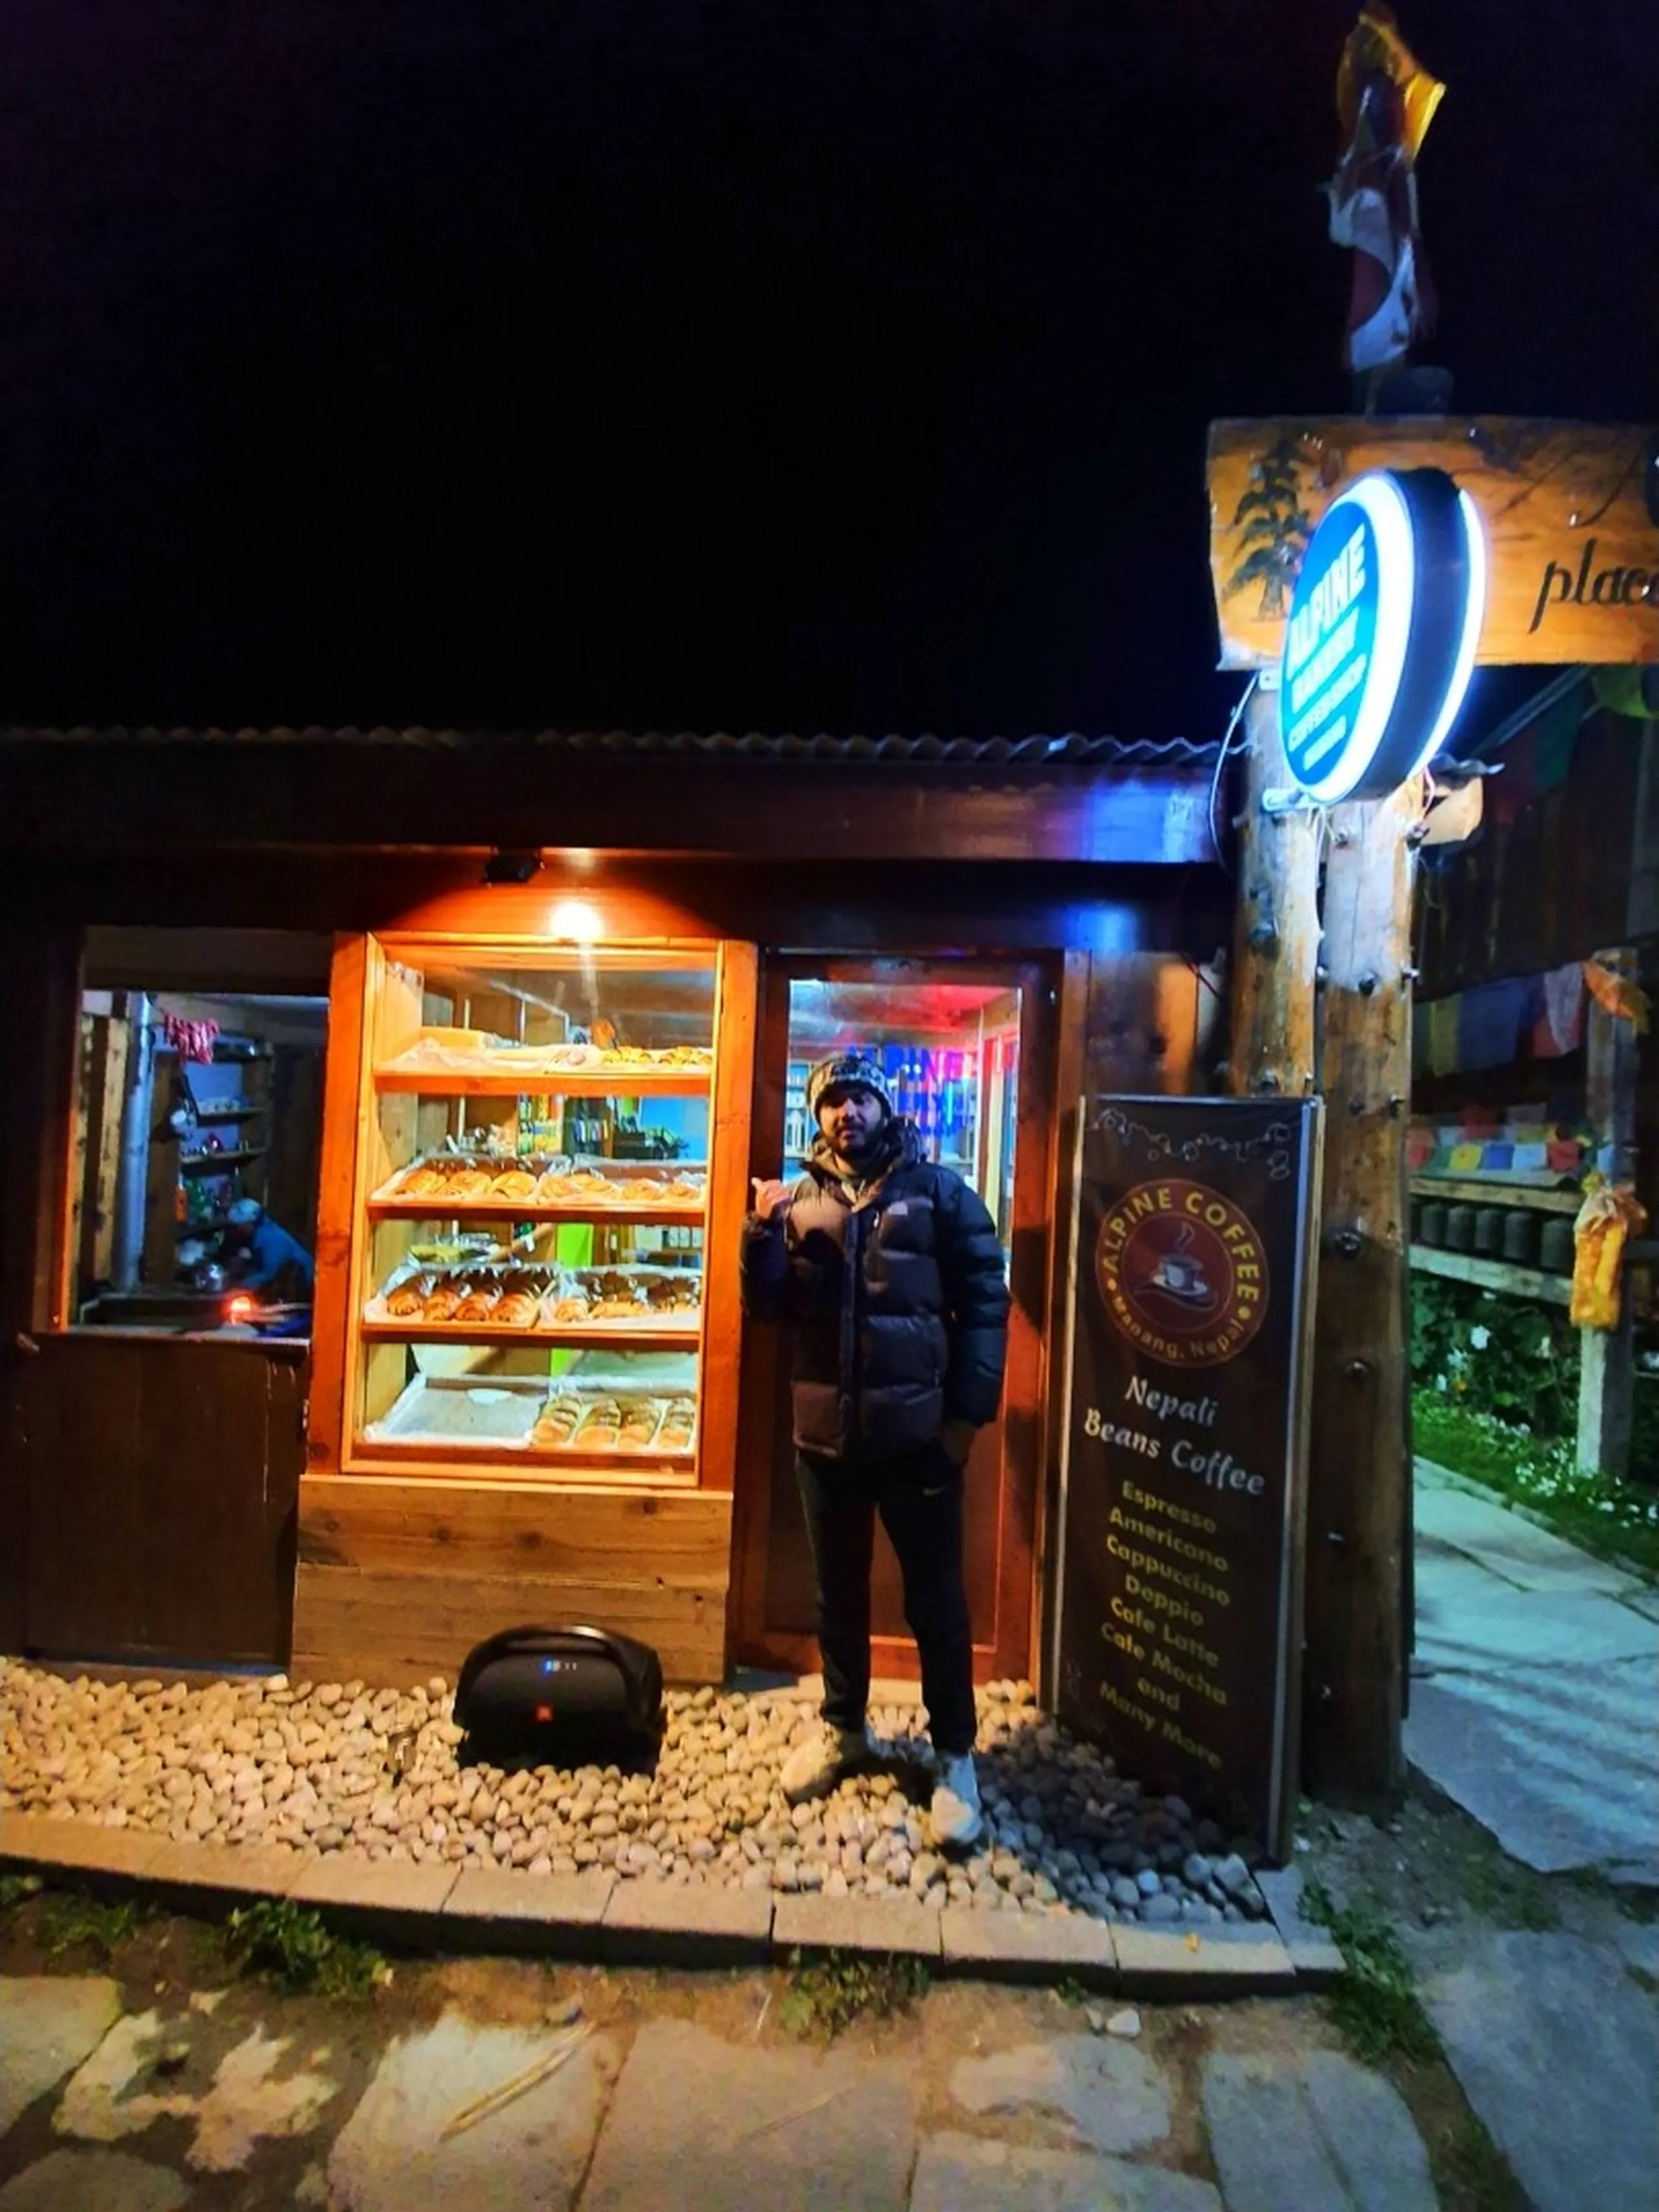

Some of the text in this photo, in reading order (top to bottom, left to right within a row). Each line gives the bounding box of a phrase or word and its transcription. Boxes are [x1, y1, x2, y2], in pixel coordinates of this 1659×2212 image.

[1286, 522, 1366, 681] ALPINE
[1102, 1187, 1260, 1302] ALPINE COFFEE
[1190, 1318, 1245, 1358] Nepal
[1124, 1375, 1220, 1426] Nepali
[1084, 1407, 1265, 1496] Beans Coffee
[1109, 1506, 1229, 1572] Americano
[1121, 1480, 1217, 1534] Espresso
[1107, 1533, 1230, 1607] Cappuccino
[1125, 1574, 1204, 1626] Doppio
[1102, 1622, 1228, 1706] Cafe Mocha
[1110, 1595, 1219, 1669] Cafe Latte
[1100, 1680, 1222, 1770] Many More
[1137, 1677, 1181, 1712] and
